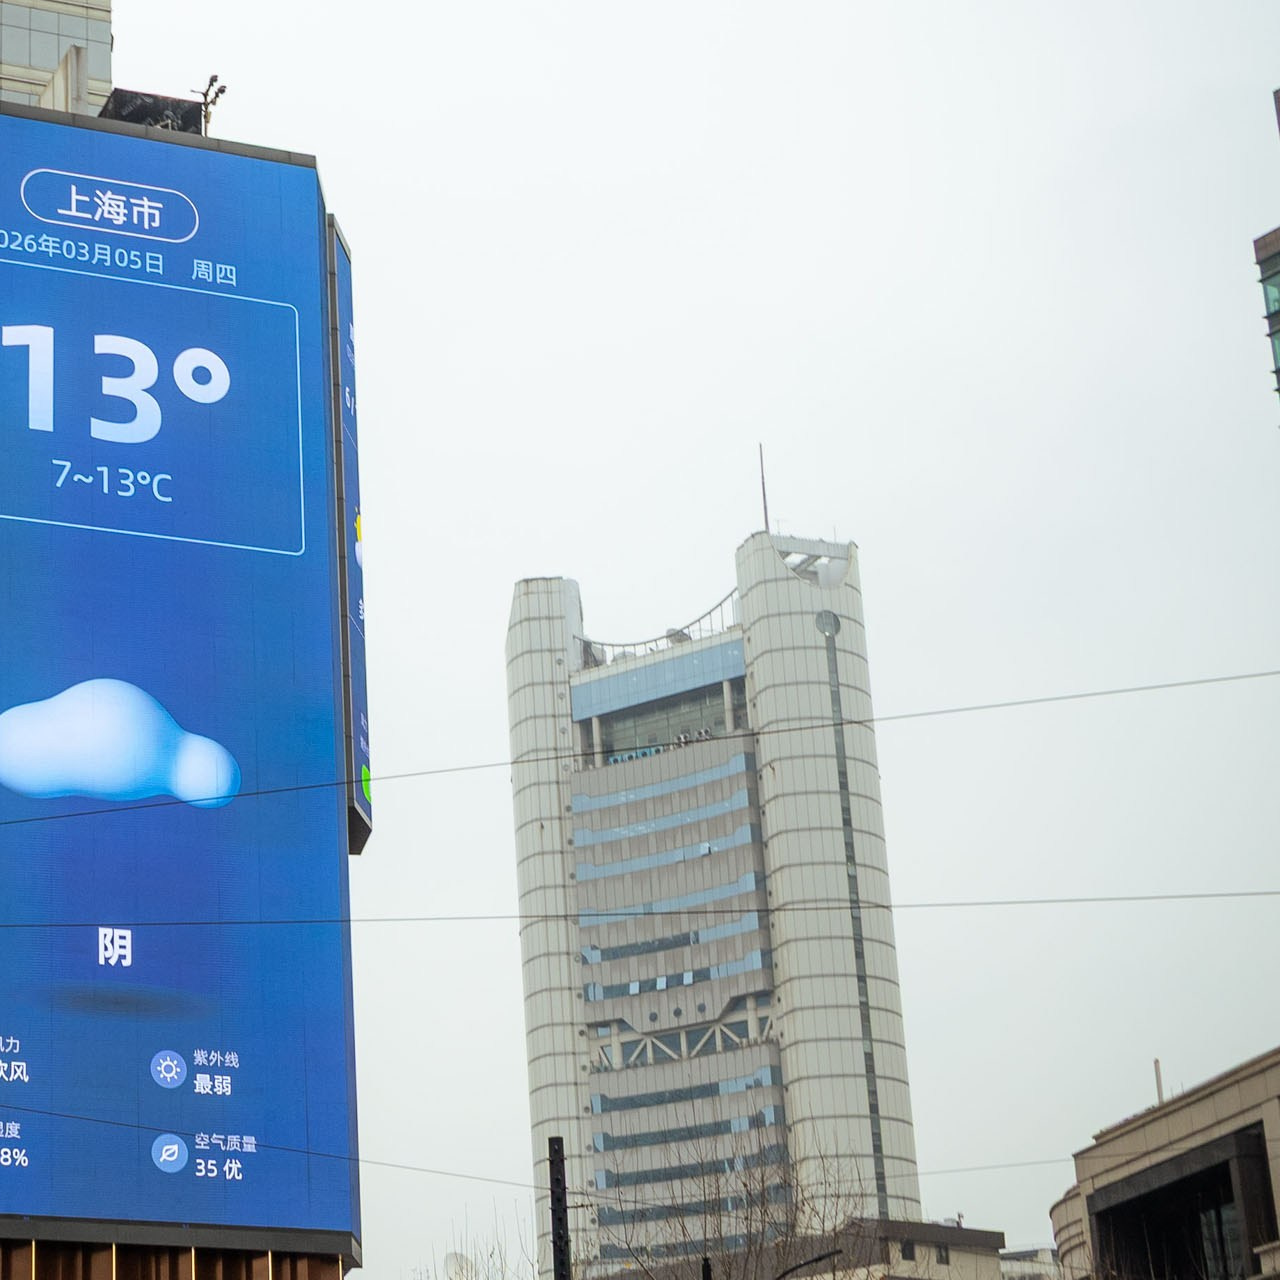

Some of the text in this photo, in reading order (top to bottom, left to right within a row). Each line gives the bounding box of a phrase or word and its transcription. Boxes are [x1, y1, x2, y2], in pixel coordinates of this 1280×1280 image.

[57, 184, 163, 229] 上海市
[191, 258, 237, 287] 周四
[1, 324, 231, 444] 13°
[98, 926, 133, 967] 阴
[193, 1048, 240, 1068] 紫外线
[193, 1073, 232, 1096] 最弱
[195, 1132, 257, 1153] 空气质量
[195, 1158, 243, 1180] 35 优
